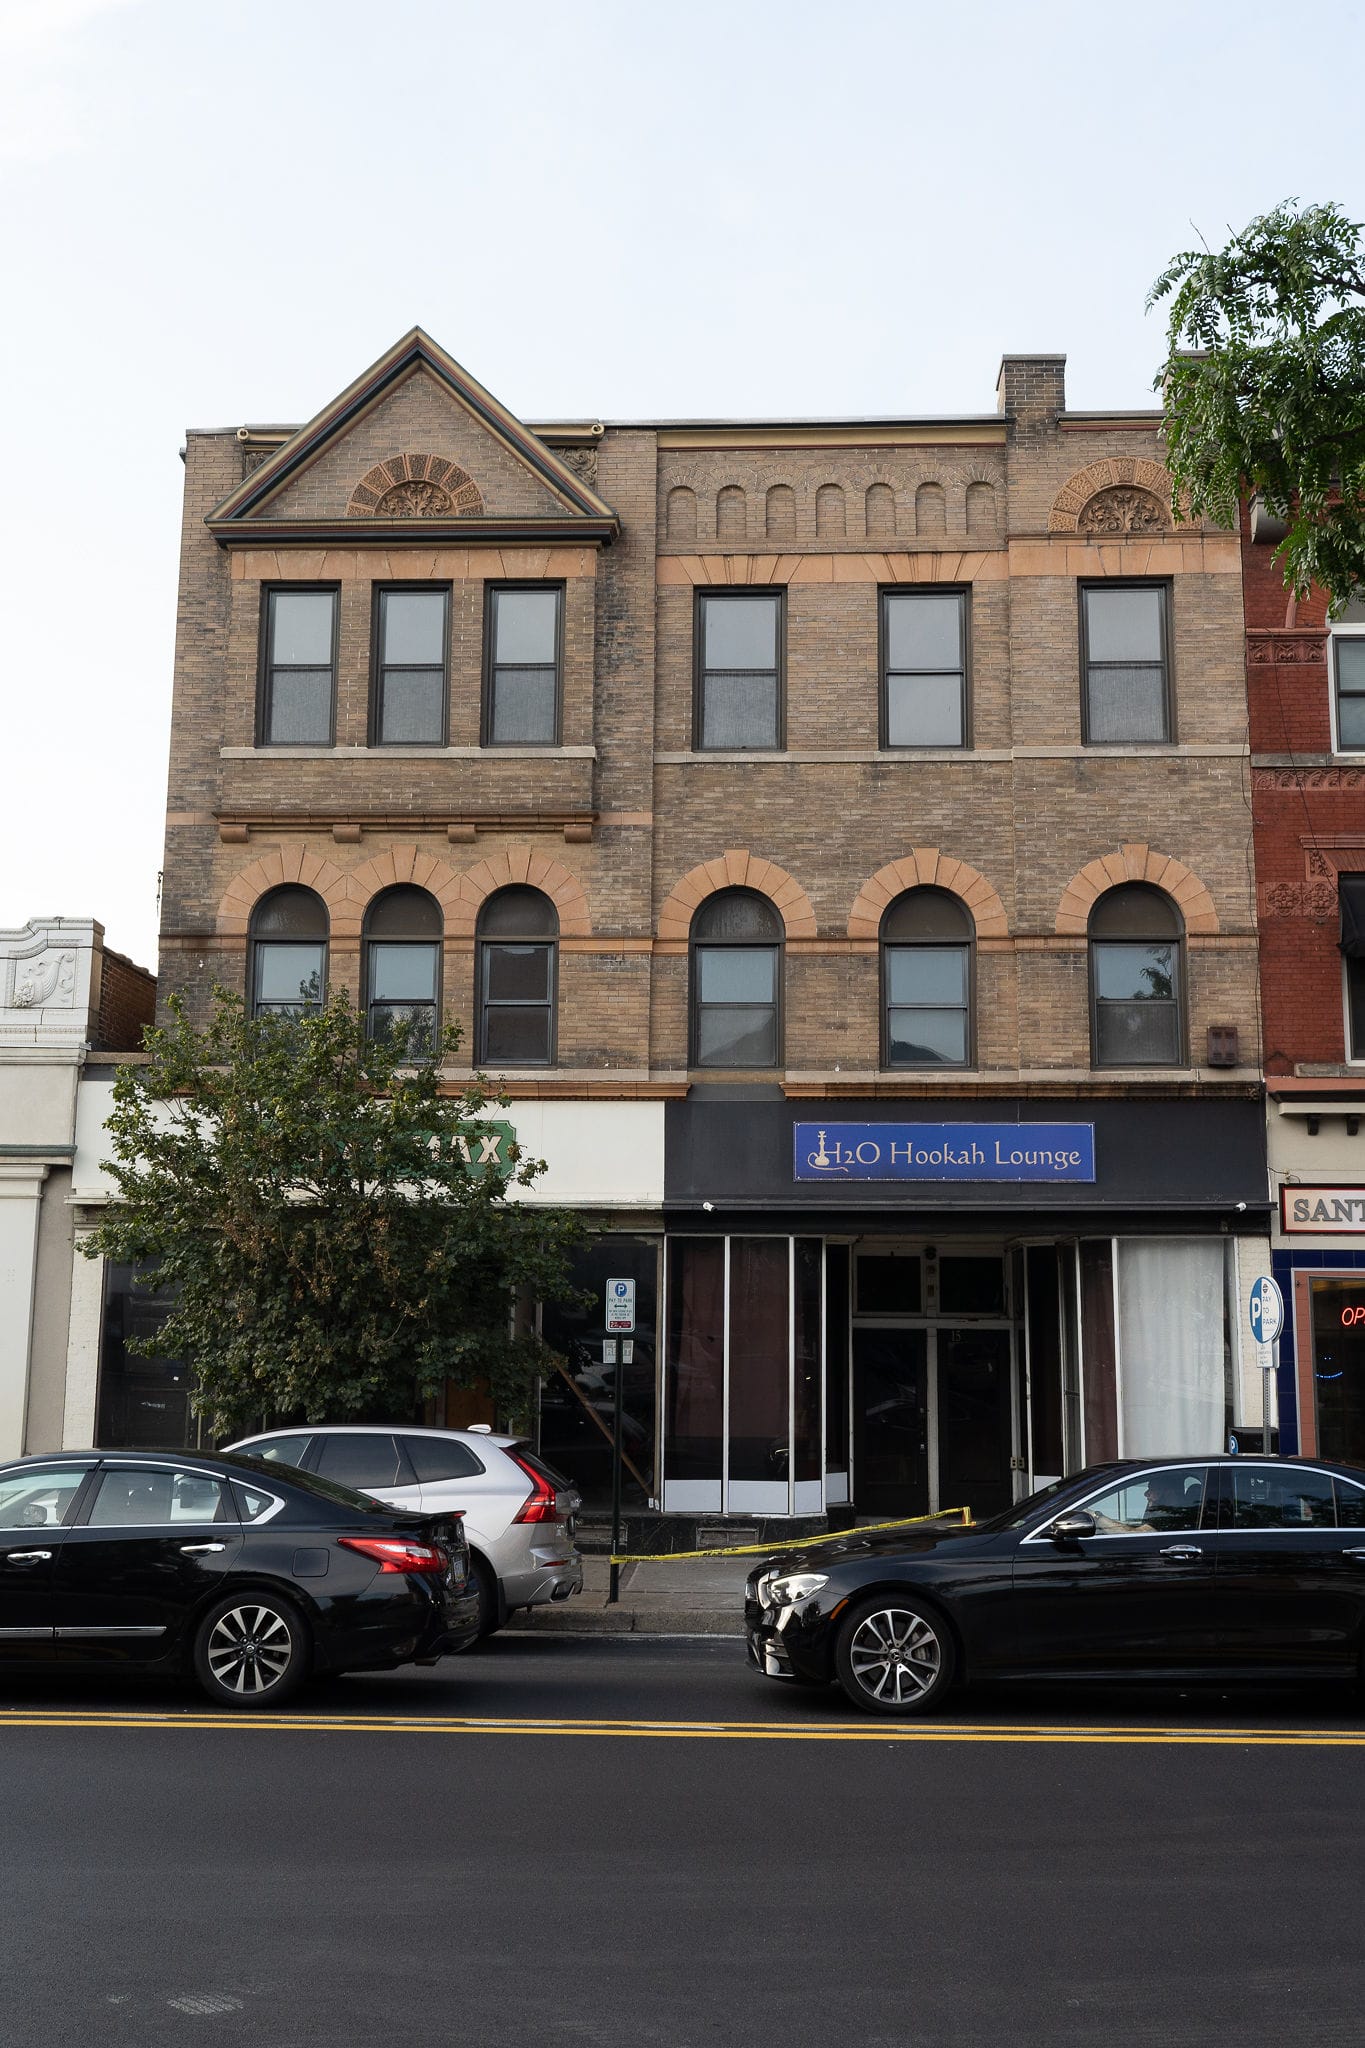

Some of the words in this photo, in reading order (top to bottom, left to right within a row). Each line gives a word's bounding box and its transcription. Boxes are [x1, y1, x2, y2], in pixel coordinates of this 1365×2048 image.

[811, 1134, 880, 1168] H2O
[890, 1142, 985, 1165] Hookah
[994, 1141, 1082, 1170] Lounge
[618, 1285, 625, 1295] P
[1252, 1297, 1261, 1326] P
[1342, 1307, 1365, 1326] OP
[606, 1347, 631, 1355] RET
